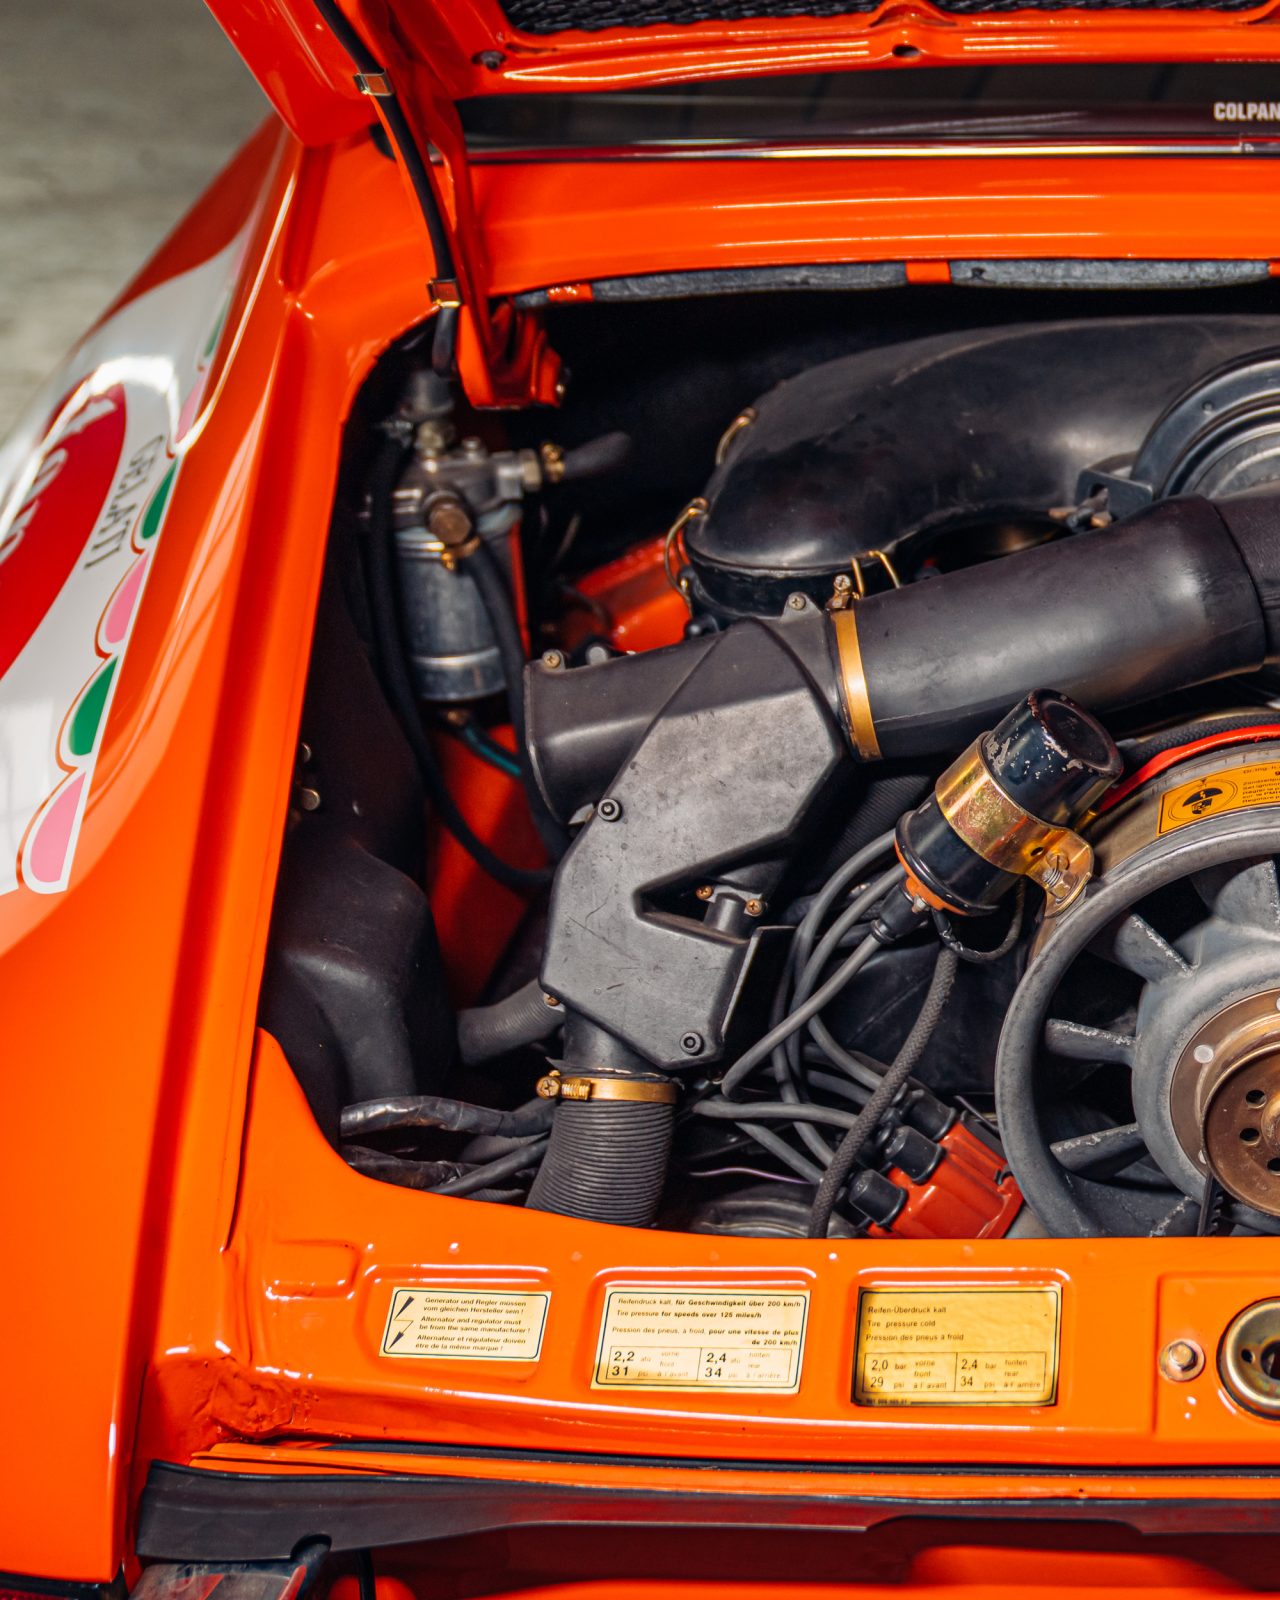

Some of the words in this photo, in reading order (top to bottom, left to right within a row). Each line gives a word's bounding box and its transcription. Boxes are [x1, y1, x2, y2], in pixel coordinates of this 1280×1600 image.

[83, 434, 164, 570] GELATI
[866, 1333, 898, 1341] Pression
[614, 1351, 635, 1363] 2,2
[706, 1352, 727, 1364] 2,4
[871, 1359, 889, 1372] 2,0
[961, 1358, 978, 1371] 2,4
[611, 1366, 629, 1376] 31
[705, 1367, 722, 1378] 34
[870, 1376, 884, 1388] 29
[961, 1375, 973, 1387] 34
